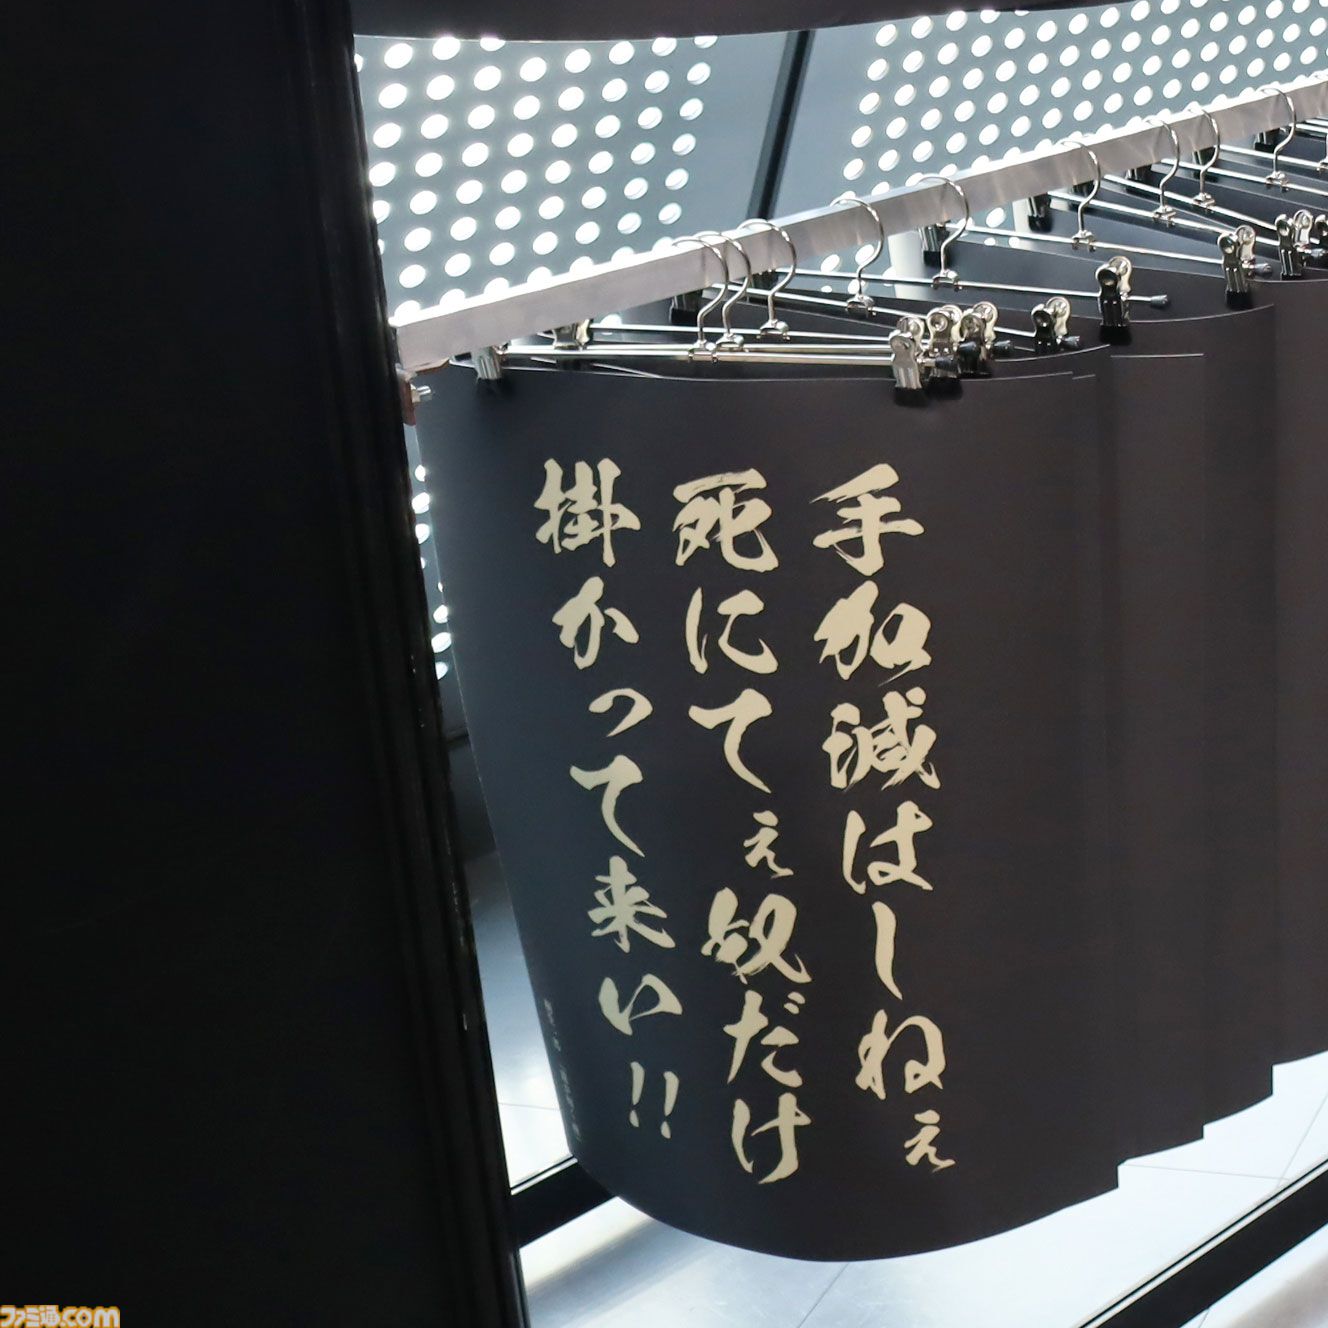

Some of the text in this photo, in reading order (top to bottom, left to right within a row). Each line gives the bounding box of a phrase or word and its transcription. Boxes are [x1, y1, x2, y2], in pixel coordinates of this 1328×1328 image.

[672, 468, 812, 1185] 死にてぇ奴だけ
[810, 462, 956, 1172] 手加減はしねぇ
